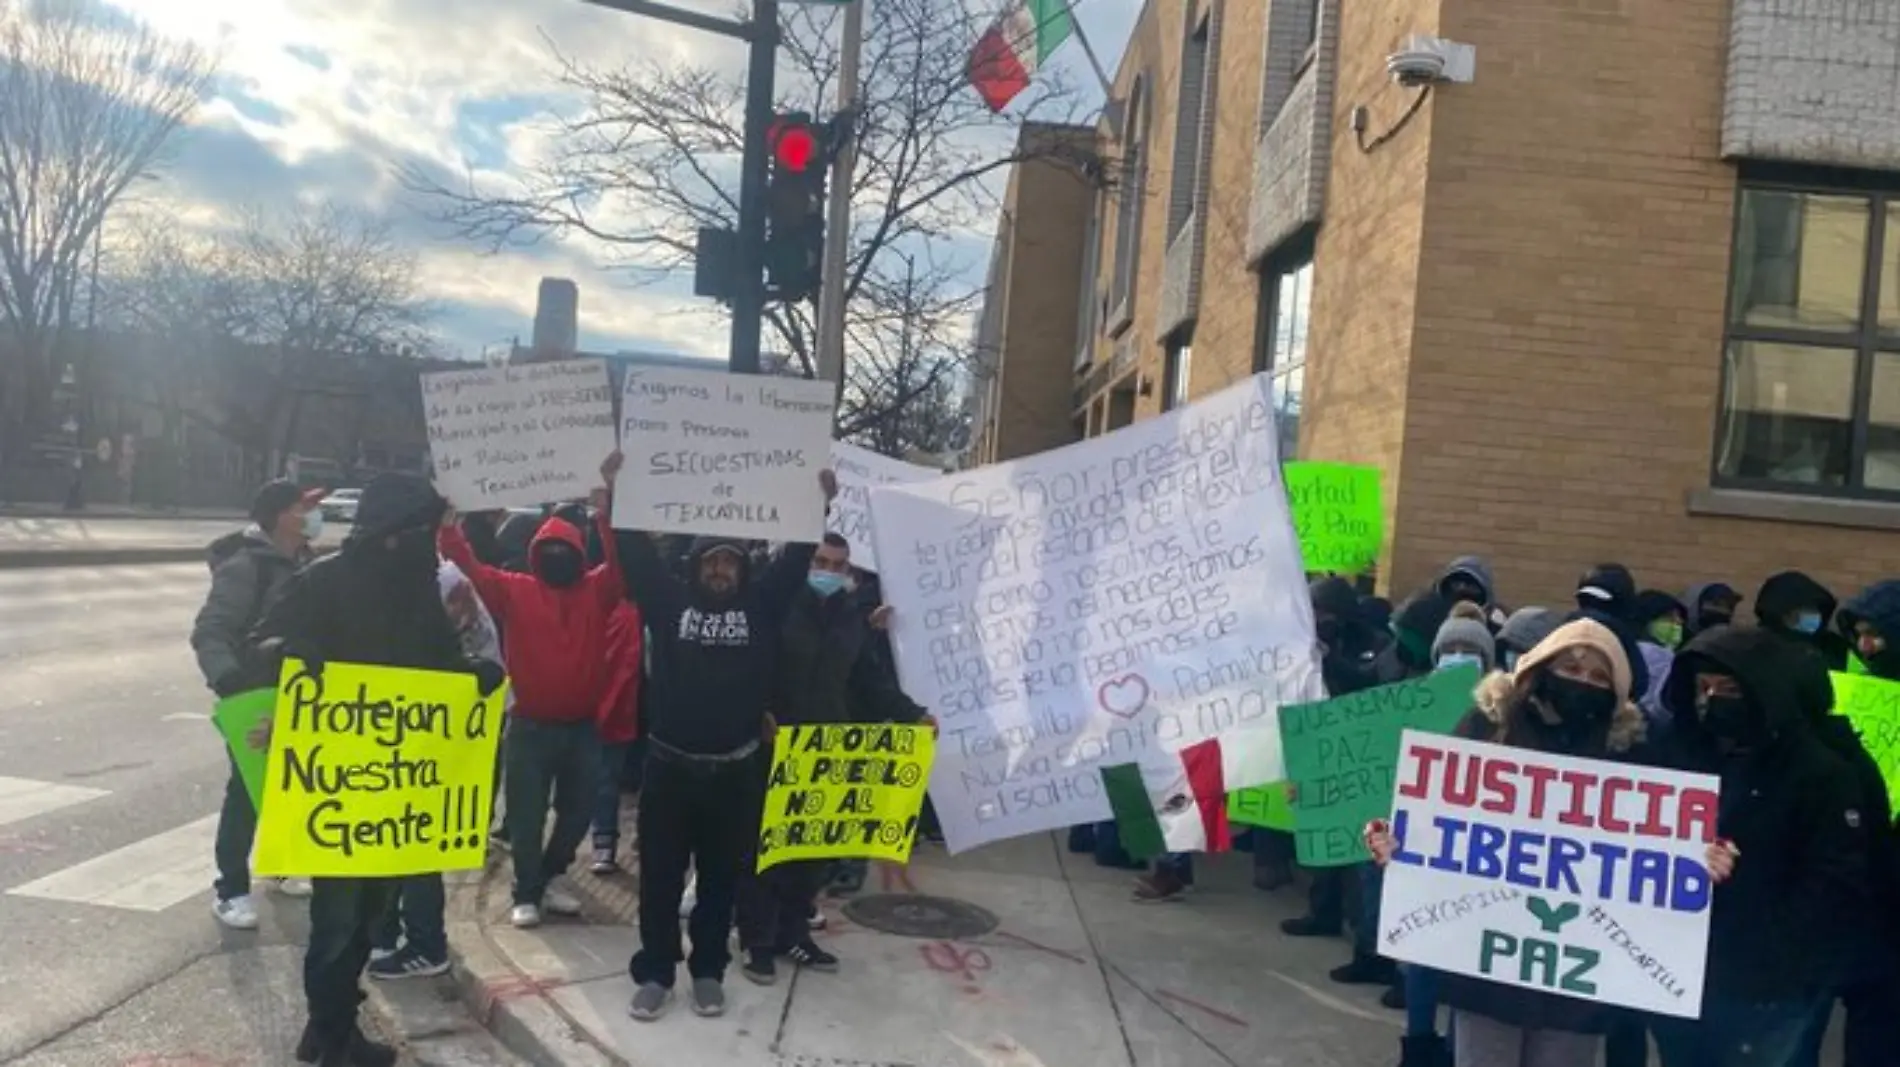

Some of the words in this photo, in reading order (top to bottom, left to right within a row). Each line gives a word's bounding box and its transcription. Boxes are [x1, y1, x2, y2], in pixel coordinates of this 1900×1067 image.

[711, 480, 735, 498] de
[916, 564, 968, 595] sur
[284, 670, 452, 748] Protejan
[465, 699, 488, 740] a
[280, 744, 443, 795] Nuestra
[769, 758, 799, 787] AL
[809, 756, 923, 788] PUEBLO
[1317, 728, 1383, 770] PAZ
[784, 788, 826, 817] NO
[835, 787, 875, 814] AL
[1300, 764, 1396, 811] LIBERT
[1398, 744, 1721, 844] JUSTICIA
[306, 783, 480, 858] Gente!!!
[1389, 808, 1712, 914] LIBERTAD
[1384, 886, 1523, 947] #TEXCAPILLA
[1525, 895, 1582, 934] Y
[1478, 928, 1601, 997] PAZ
[1586, 903, 1688, 1000] #TEXCAPILLA
